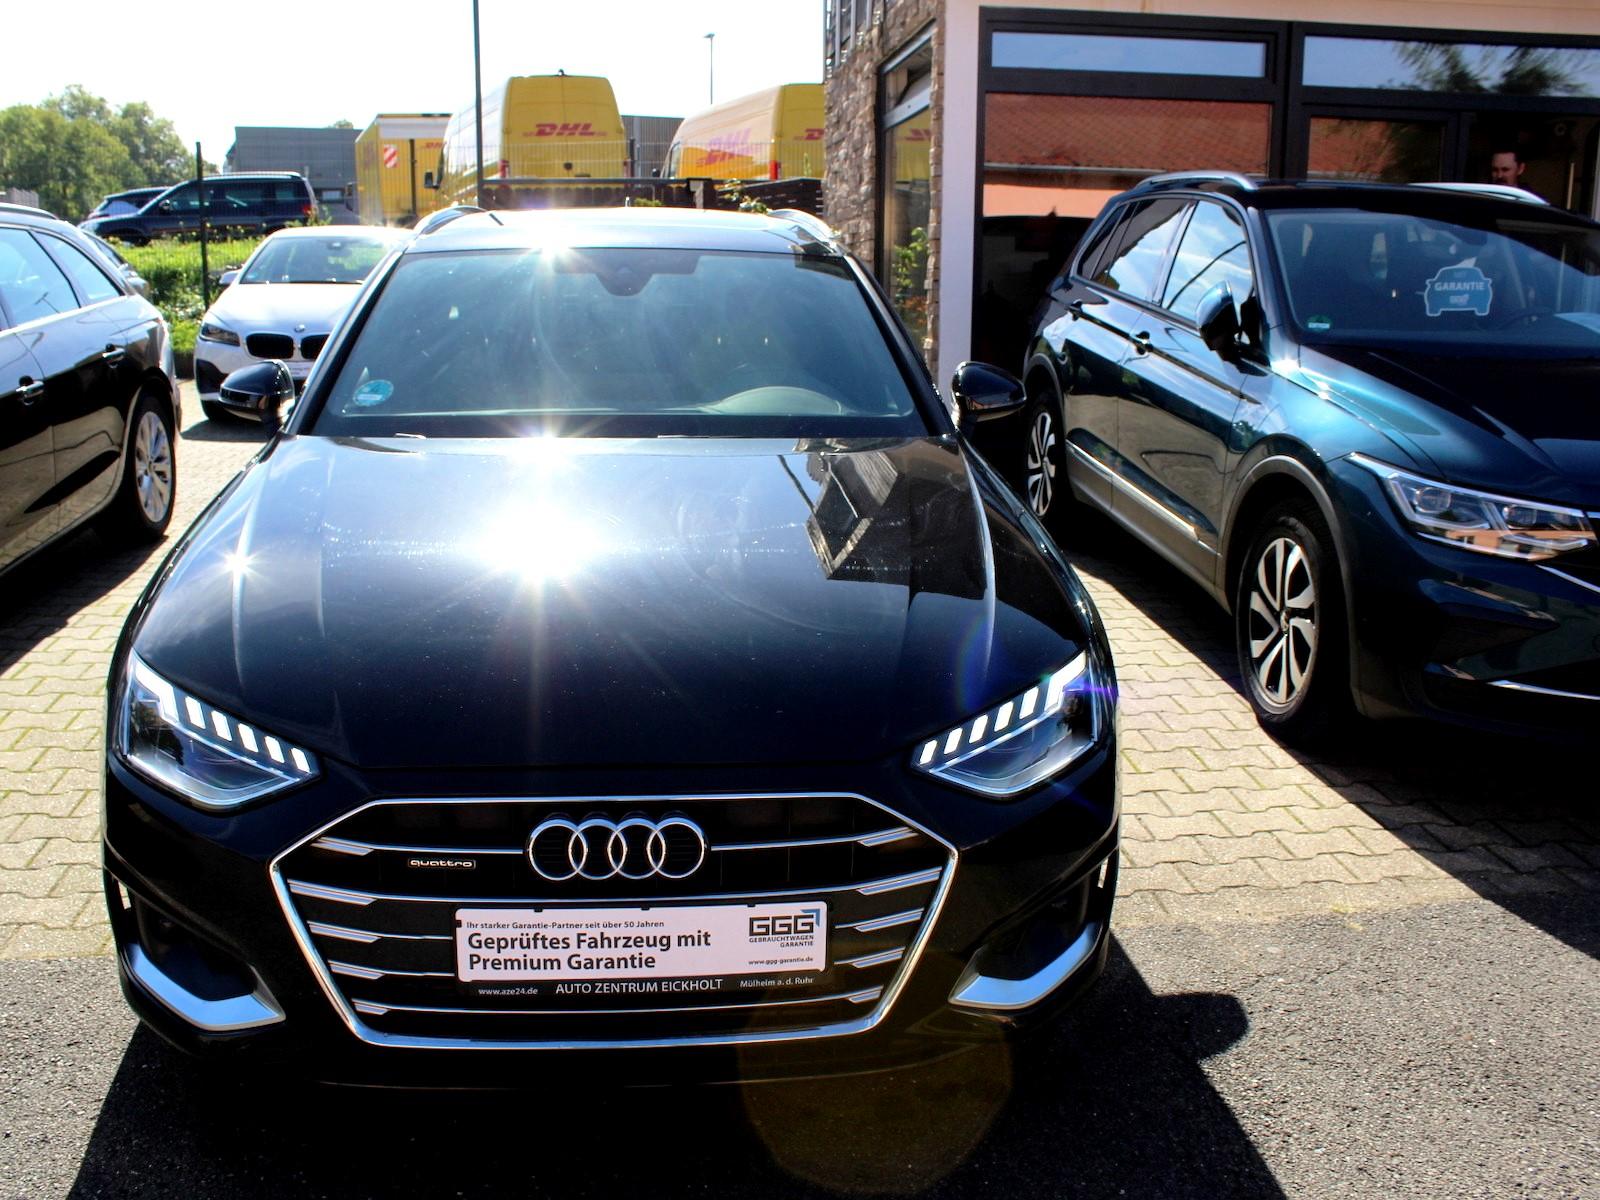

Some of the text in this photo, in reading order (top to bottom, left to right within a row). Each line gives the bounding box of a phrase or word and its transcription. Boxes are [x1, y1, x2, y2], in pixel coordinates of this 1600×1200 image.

[536, 123, 595, 137] DHL
[1434, 281, 1485, 292] GARANTIE
[410, 859, 473, 868] quattro
[512, 921, 583, 929] Garantie-Partner
[585, 921, 600, 929] seit
[603, 920, 621, 929] über
[637, 920, 664, 929] Jahren
[749, 914, 814, 936] GGG
[468, 930, 711, 953] Geprüftes Fahrzeug mit
[749, 935, 814, 943] GEBRAUCHTWAGEN
[469, 953, 656, 971] Premium Garantie
[748, 956, 814, 965] www.ggg-garantie.de
[555, 979, 723, 994] AUTO ZENTRUM EICKHOLT
[740, 979, 775, 988] Mülheim
[795, 976, 813, 985] Ruhr
[478, 987, 538, 996] www.aze24.de
